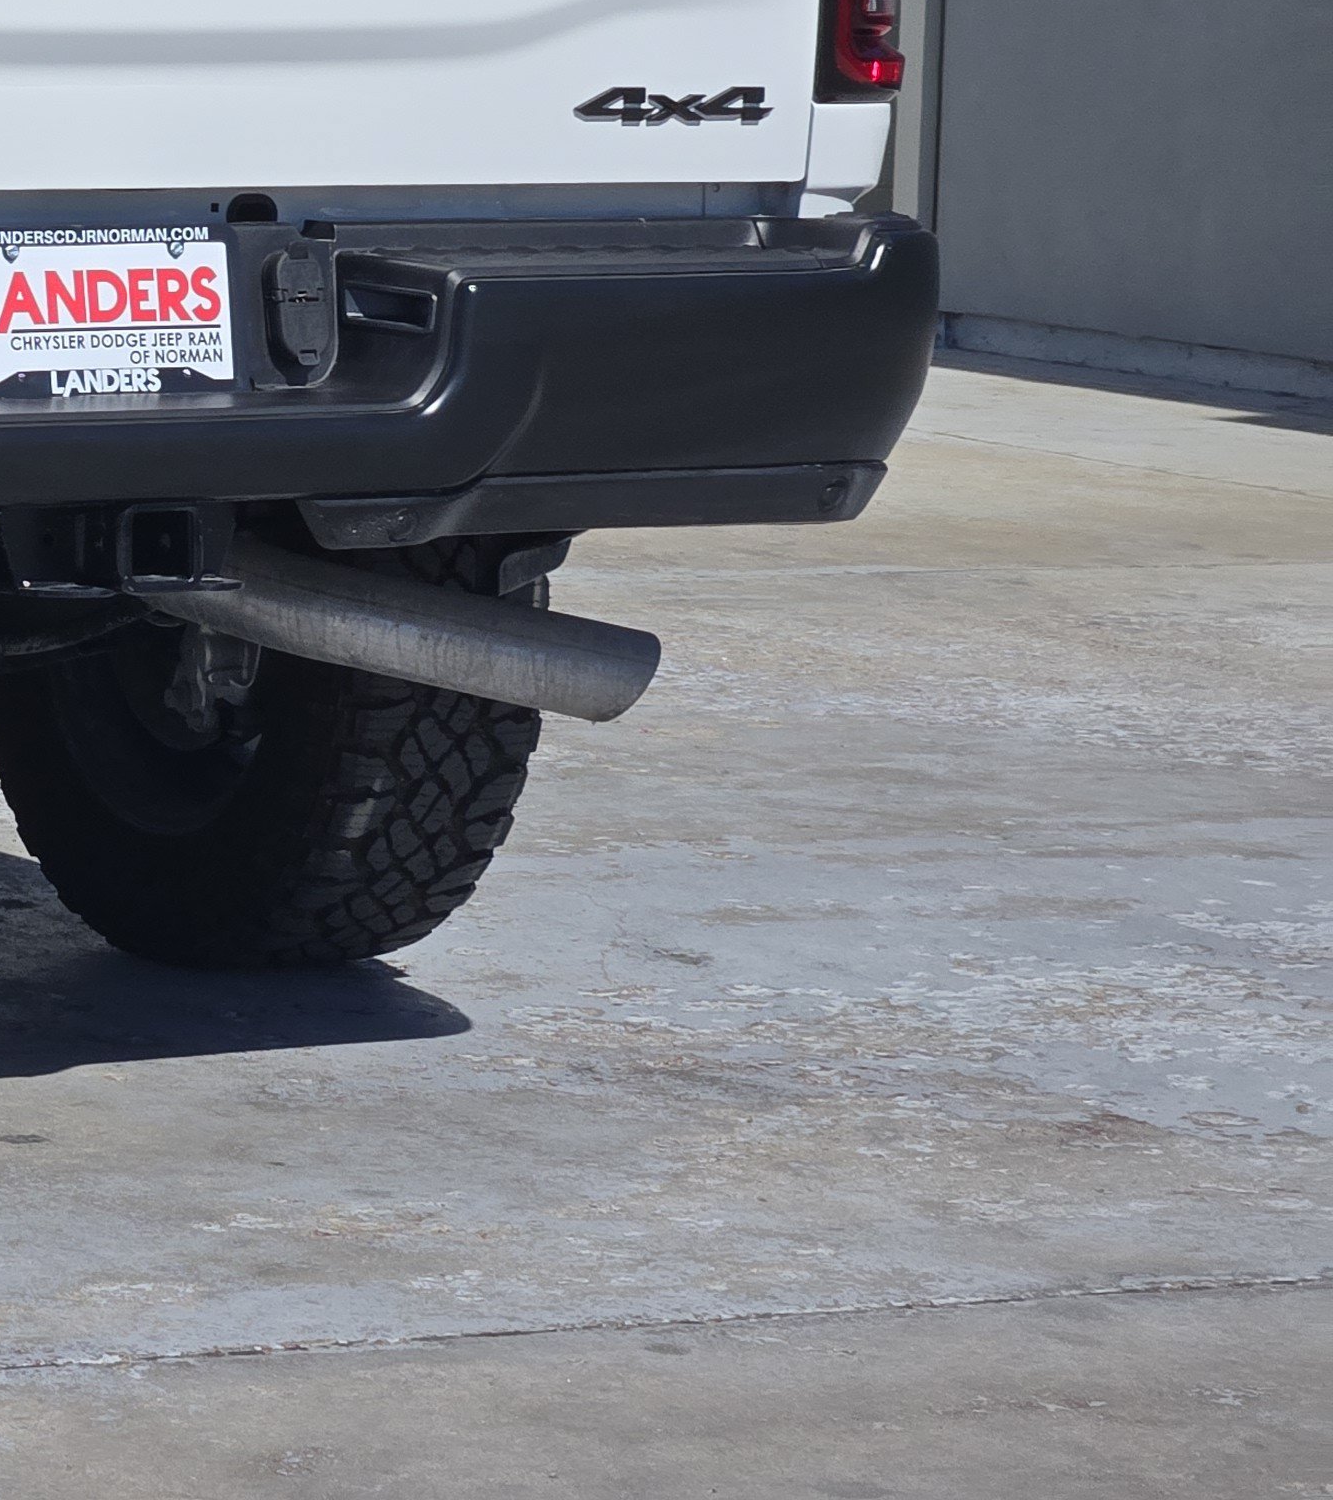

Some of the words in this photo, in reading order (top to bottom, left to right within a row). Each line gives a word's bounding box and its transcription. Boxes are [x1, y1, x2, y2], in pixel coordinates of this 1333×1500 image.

[573, 87, 774, 126] 4x4
[10, 334, 86, 351] CHRYSLER
[90, 333, 147, 349] DODGE
[151, 332, 183, 348] JEEP
[188, 331, 222, 346] RAM
[129, 350, 151, 365] OF
[154, 348, 223, 364] NORMAN
[50, 367, 162, 397] LANDERS
